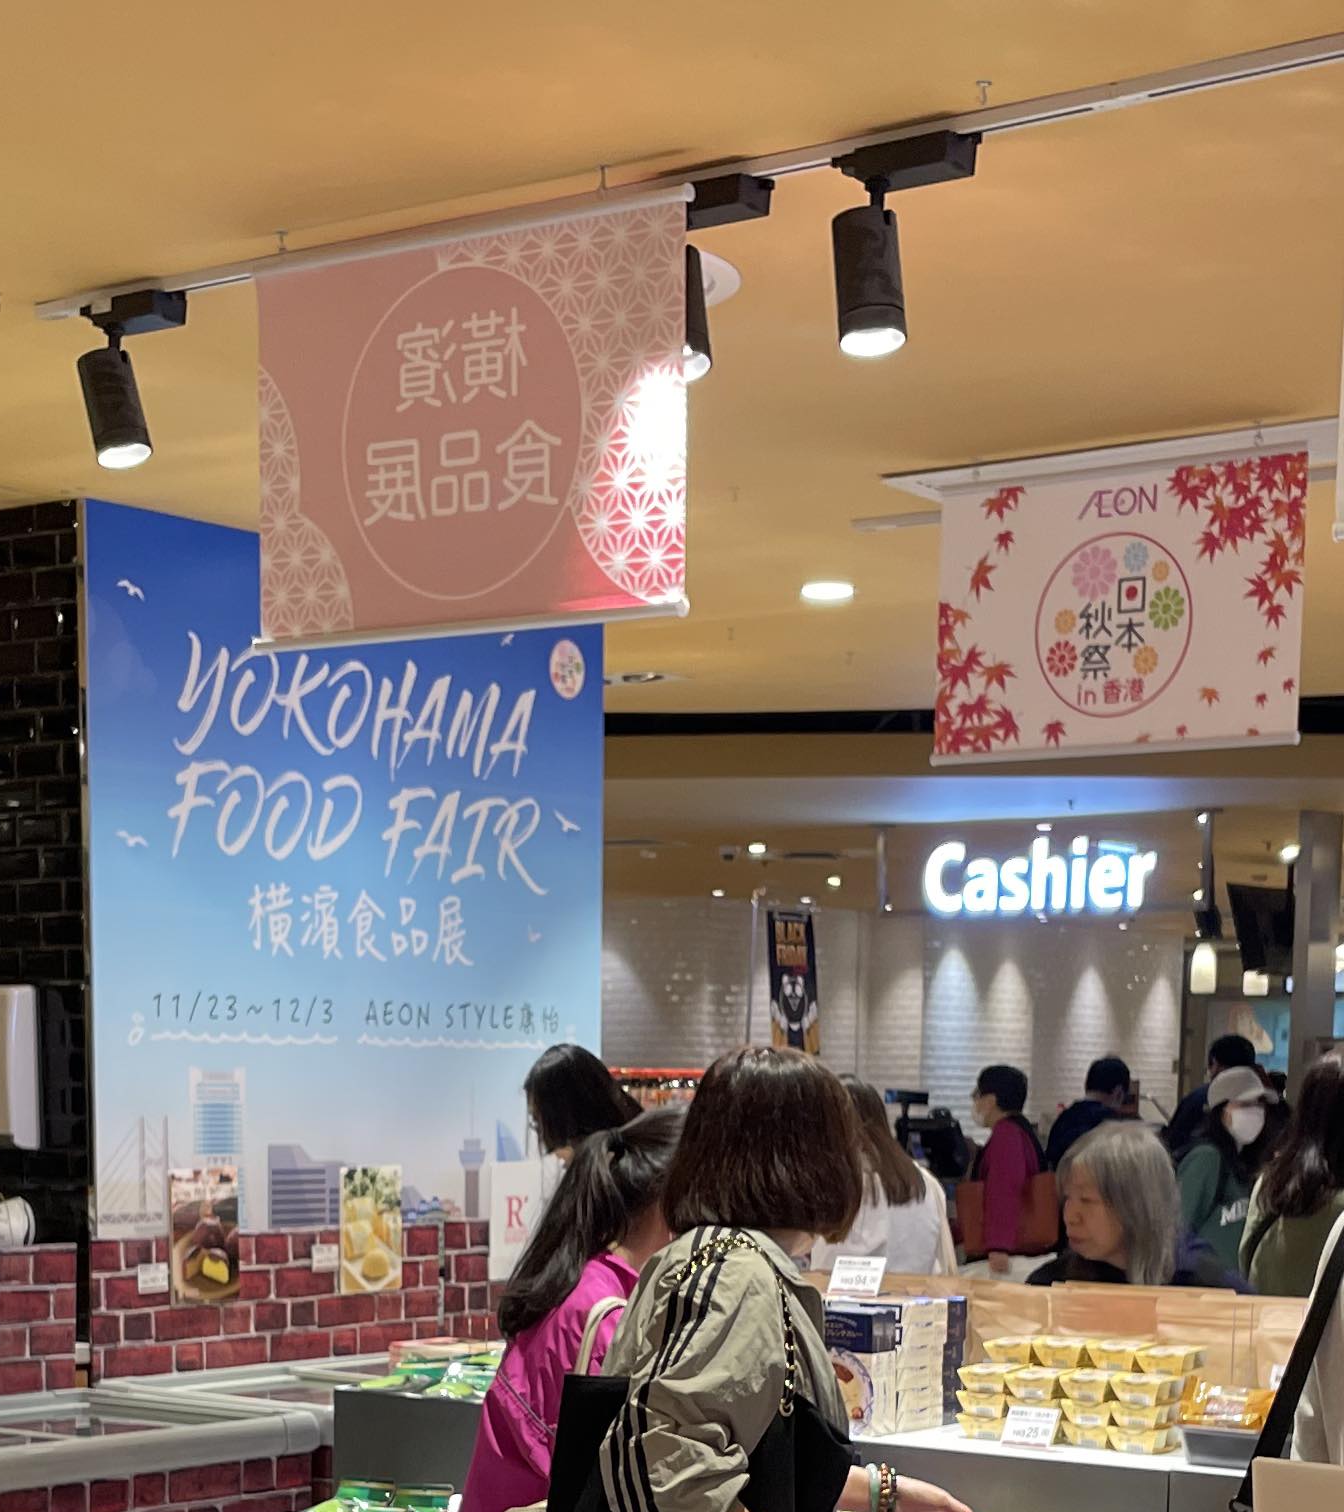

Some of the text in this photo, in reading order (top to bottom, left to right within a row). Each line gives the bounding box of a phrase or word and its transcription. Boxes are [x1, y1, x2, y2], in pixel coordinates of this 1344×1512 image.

[173, 630, 537, 781] YOKOHAMA
[1077, 678, 1145, 706] in 香港
[167, 759, 548, 896] FOOD FAIR
[924, 835, 1156, 914] Cashier
[365, 998, 432, 1030] AEON
